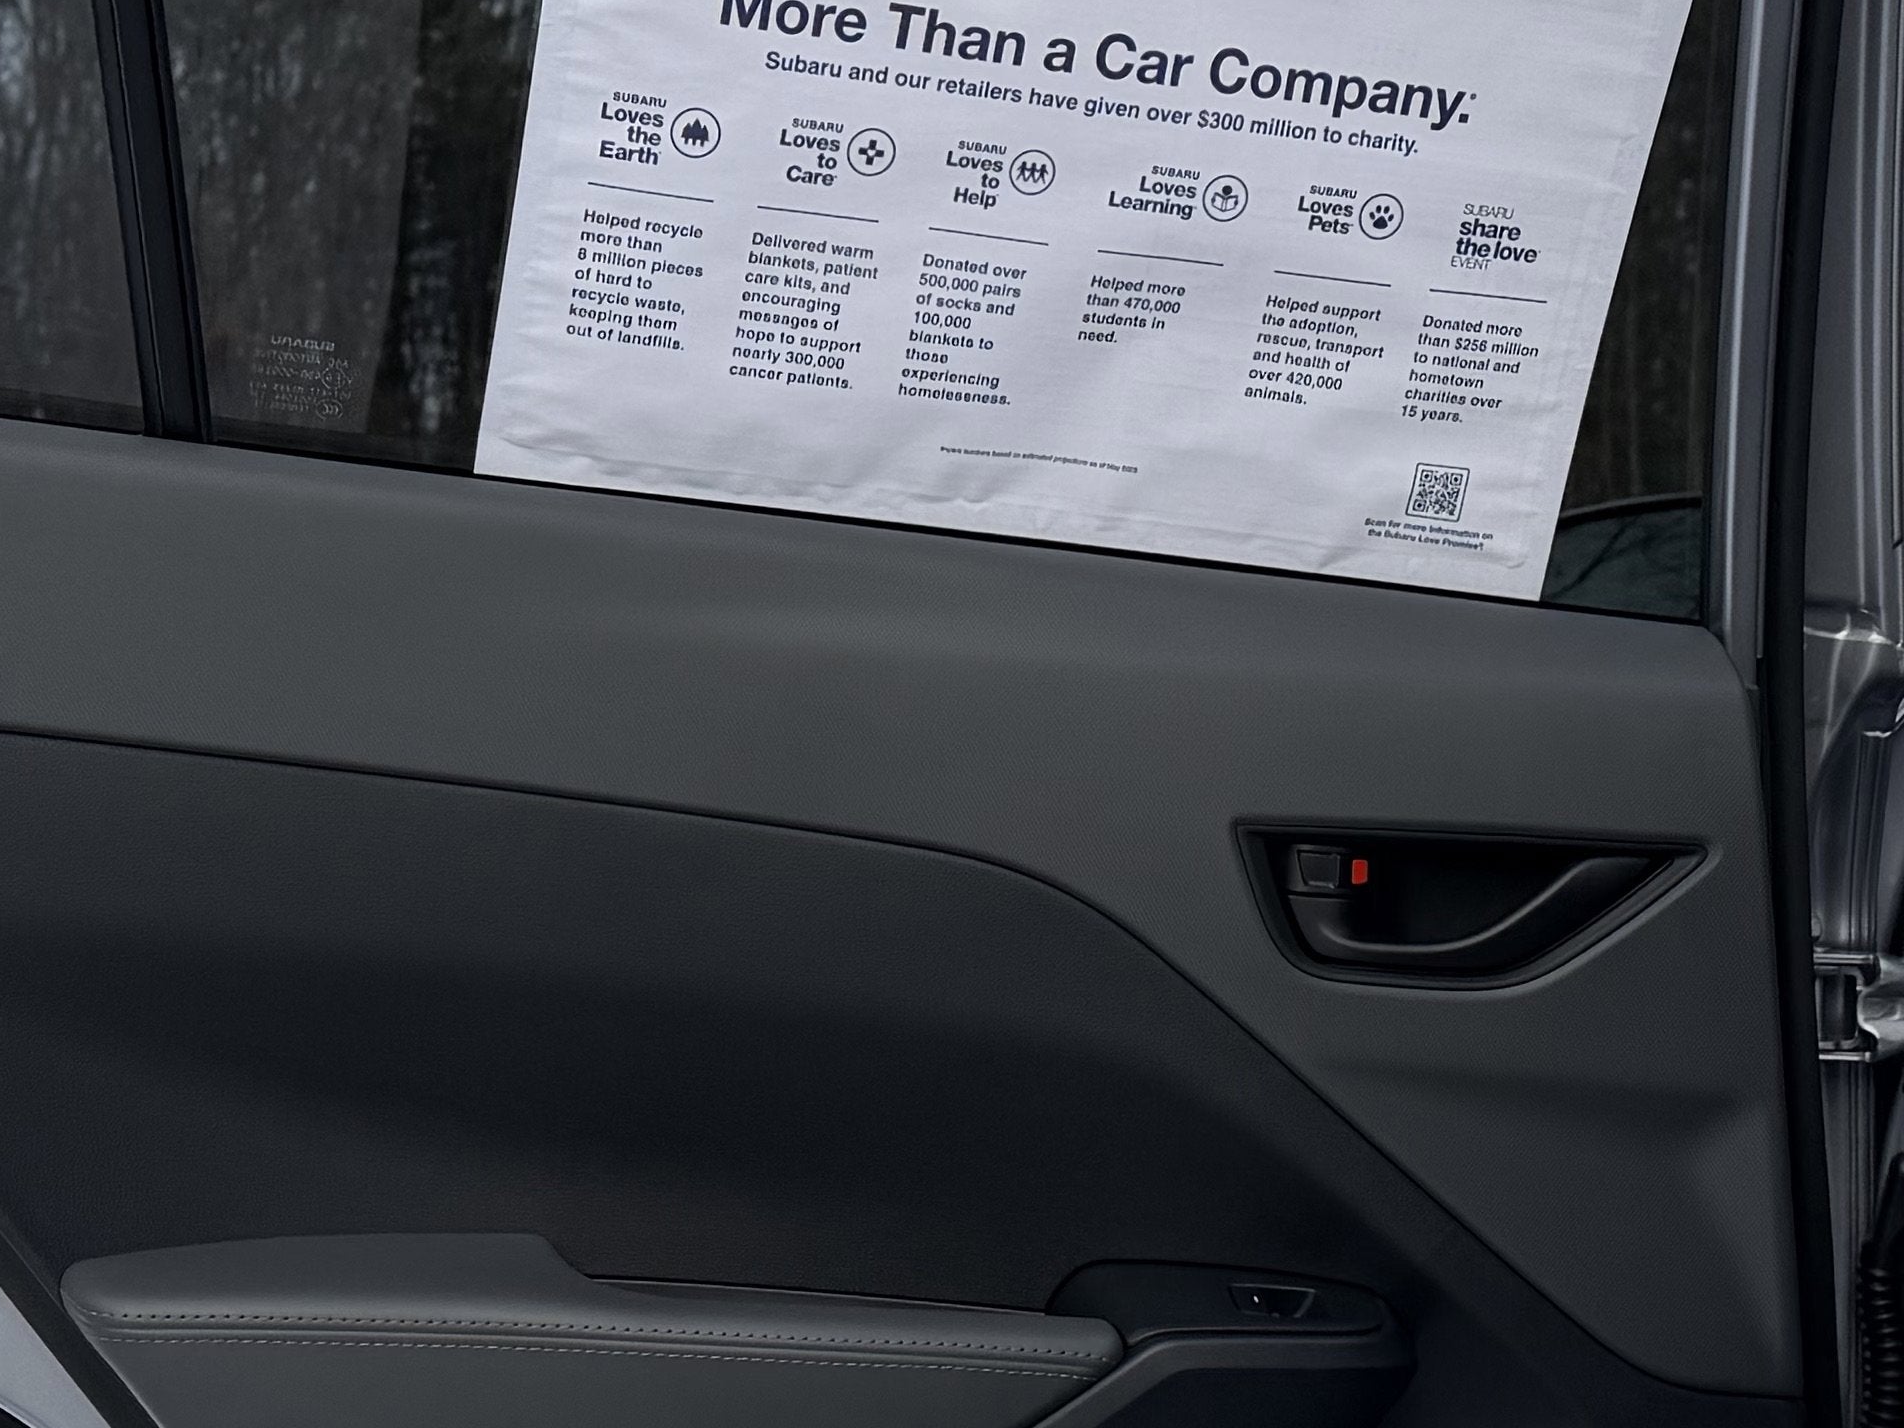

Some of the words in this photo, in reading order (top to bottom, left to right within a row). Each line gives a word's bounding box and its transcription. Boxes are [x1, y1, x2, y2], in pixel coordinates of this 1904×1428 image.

[888, 2, 1025, 66] Than
[1043, 38, 1076, 73] a
[1095, 33, 1194, 87] Car
[611, 90, 668, 109] SUBARU
[765, 51, 842, 78] Subaru
[848, 66, 889, 84] and
[894, 72, 931, 89] our
[936, 78, 1022, 103] retailers
[1028, 87, 1078, 110] have
[1083, 96, 1140, 119] given
[1146, 107, 1192, 125] over
[1197, 109, 1244, 131] $300
[1249, 117, 1316, 141] million
[1323, 125, 1342, 144] to
[1347, 129, 1418, 157] charity.
[599, 100, 665, 129] Loves
[790, 116, 845, 134] SUBARU
[625, 124, 662, 147] the
[778, 127, 841, 153] Loves
[956, 139, 1008, 156] SUBARU
[815, 151, 838, 171] to
[945, 149, 1004, 174] Loves
[1150, 164, 1201, 181] SUBARU
[980, 172, 1001, 190] to
[1138, 174, 1198, 200] Loves
[1308, 184, 1358, 200] SUBARU
[1296, 194, 1355, 218] Loves
[1461, 202, 1515, 221] SUBARU
[582, 207, 642, 231] Helped
[643, 220, 704, 239] recycle
[1458, 216, 1522, 242] share
[579, 230, 623, 248] more
[626, 234, 663, 254] than
[750, 230, 828, 255] Delivered
[830, 243, 874, 260] warm
[1454, 236, 1492, 259] the
[576, 246, 588, 261] 8
[591, 250, 647, 271] million
[649, 258, 704, 278] pieces
[747, 249, 820, 275] blankets,
[822, 262, 879, 281] patient
[921, 252, 990, 276] Donated
[991, 265, 1028, 281] over
[1449, 254, 1493, 271] EVENT
[573, 266, 593, 282] of
[594, 268, 633, 288] hard
[636, 275, 653, 291] to
[743, 270, 780, 286] care
[782, 273, 817, 294] kits,
[819, 280, 851, 296] and
[917, 271, 980, 293] 500,000
[981, 282, 1022, 299] pairs
[1089, 274, 1145, 294] Helped
[1145, 282, 1187, 297] more
[570, 287, 630, 307] recycle
[633, 296, 685, 316] waste,
[740, 289, 841, 317] encouraging
[914, 291, 933, 307] of
[934, 296, 982, 313] socks
[984, 302, 1016, 317] and
[1085, 292, 1120, 308] than
[1122, 296, 1182, 315] 470,000
[1264, 293, 1320, 314] Helped
[1320, 303, 1382, 322] support
[568, 302, 634, 329] keeping
[637, 313, 678, 332] them
[737, 309, 819, 331] messages
[822, 318, 840, 332] of
[913, 309, 972, 330] 100,000
[1081, 311, 1148, 329] students
[1149, 315, 1166, 330] in
[1261, 311, 1286, 328] the
[1287, 317, 1358, 339] adoption,
[1421, 313, 1484, 334] Donated
[1484, 323, 1523, 338] more
[565, 323, 593, 339] out
[596, 327, 615, 342] of
[616, 329, 685, 351] landfills.
[734, 324, 776, 344] hope
[779, 330, 796, 346] to
[799, 335, 862, 354] support
[908, 328, 974, 349] blankets
[977, 336, 995, 351] to
[1076, 329, 1118, 344] need.
[1255, 331, 1311, 352] rescue,
[1314, 337, 1385, 359] transport
[1417, 331, 1451, 349] than
[1453, 336, 1489, 353] $256
[1490, 340, 1540, 358] million
[731, 345, 782, 365] nearly
[783, 350, 846, 371] 300,000
[904, 347, 949, 365] those
[1251, 349, 1282, 365] and
[1283, 350, 1331, 371] health
[1334, 358, 1351, 373] of
[1412, 350, 1429, 364] to
[1431, 354, 1491, 372] national
[1491, 360, 1522, 375] and
[728, 364, 784, 381] cancer
[785, 371, 853, 390] patients.
[900, 367, 1001, 391] experiencing
[1247, 368, 1283, 383] over
[1284, 370, 1343, 391] 420,000
[1407, 367, 1485, 390] hometown
[897, 381, 1011, 406] homelessness.
[1243, 385, 1307, 406] animals.
[1403, 387, 1467, 406] charities
[1469, 395, 1503, 409] over
[1401, 403, 1419, 418] 15
[1419, 408, 1463, 423] years.
